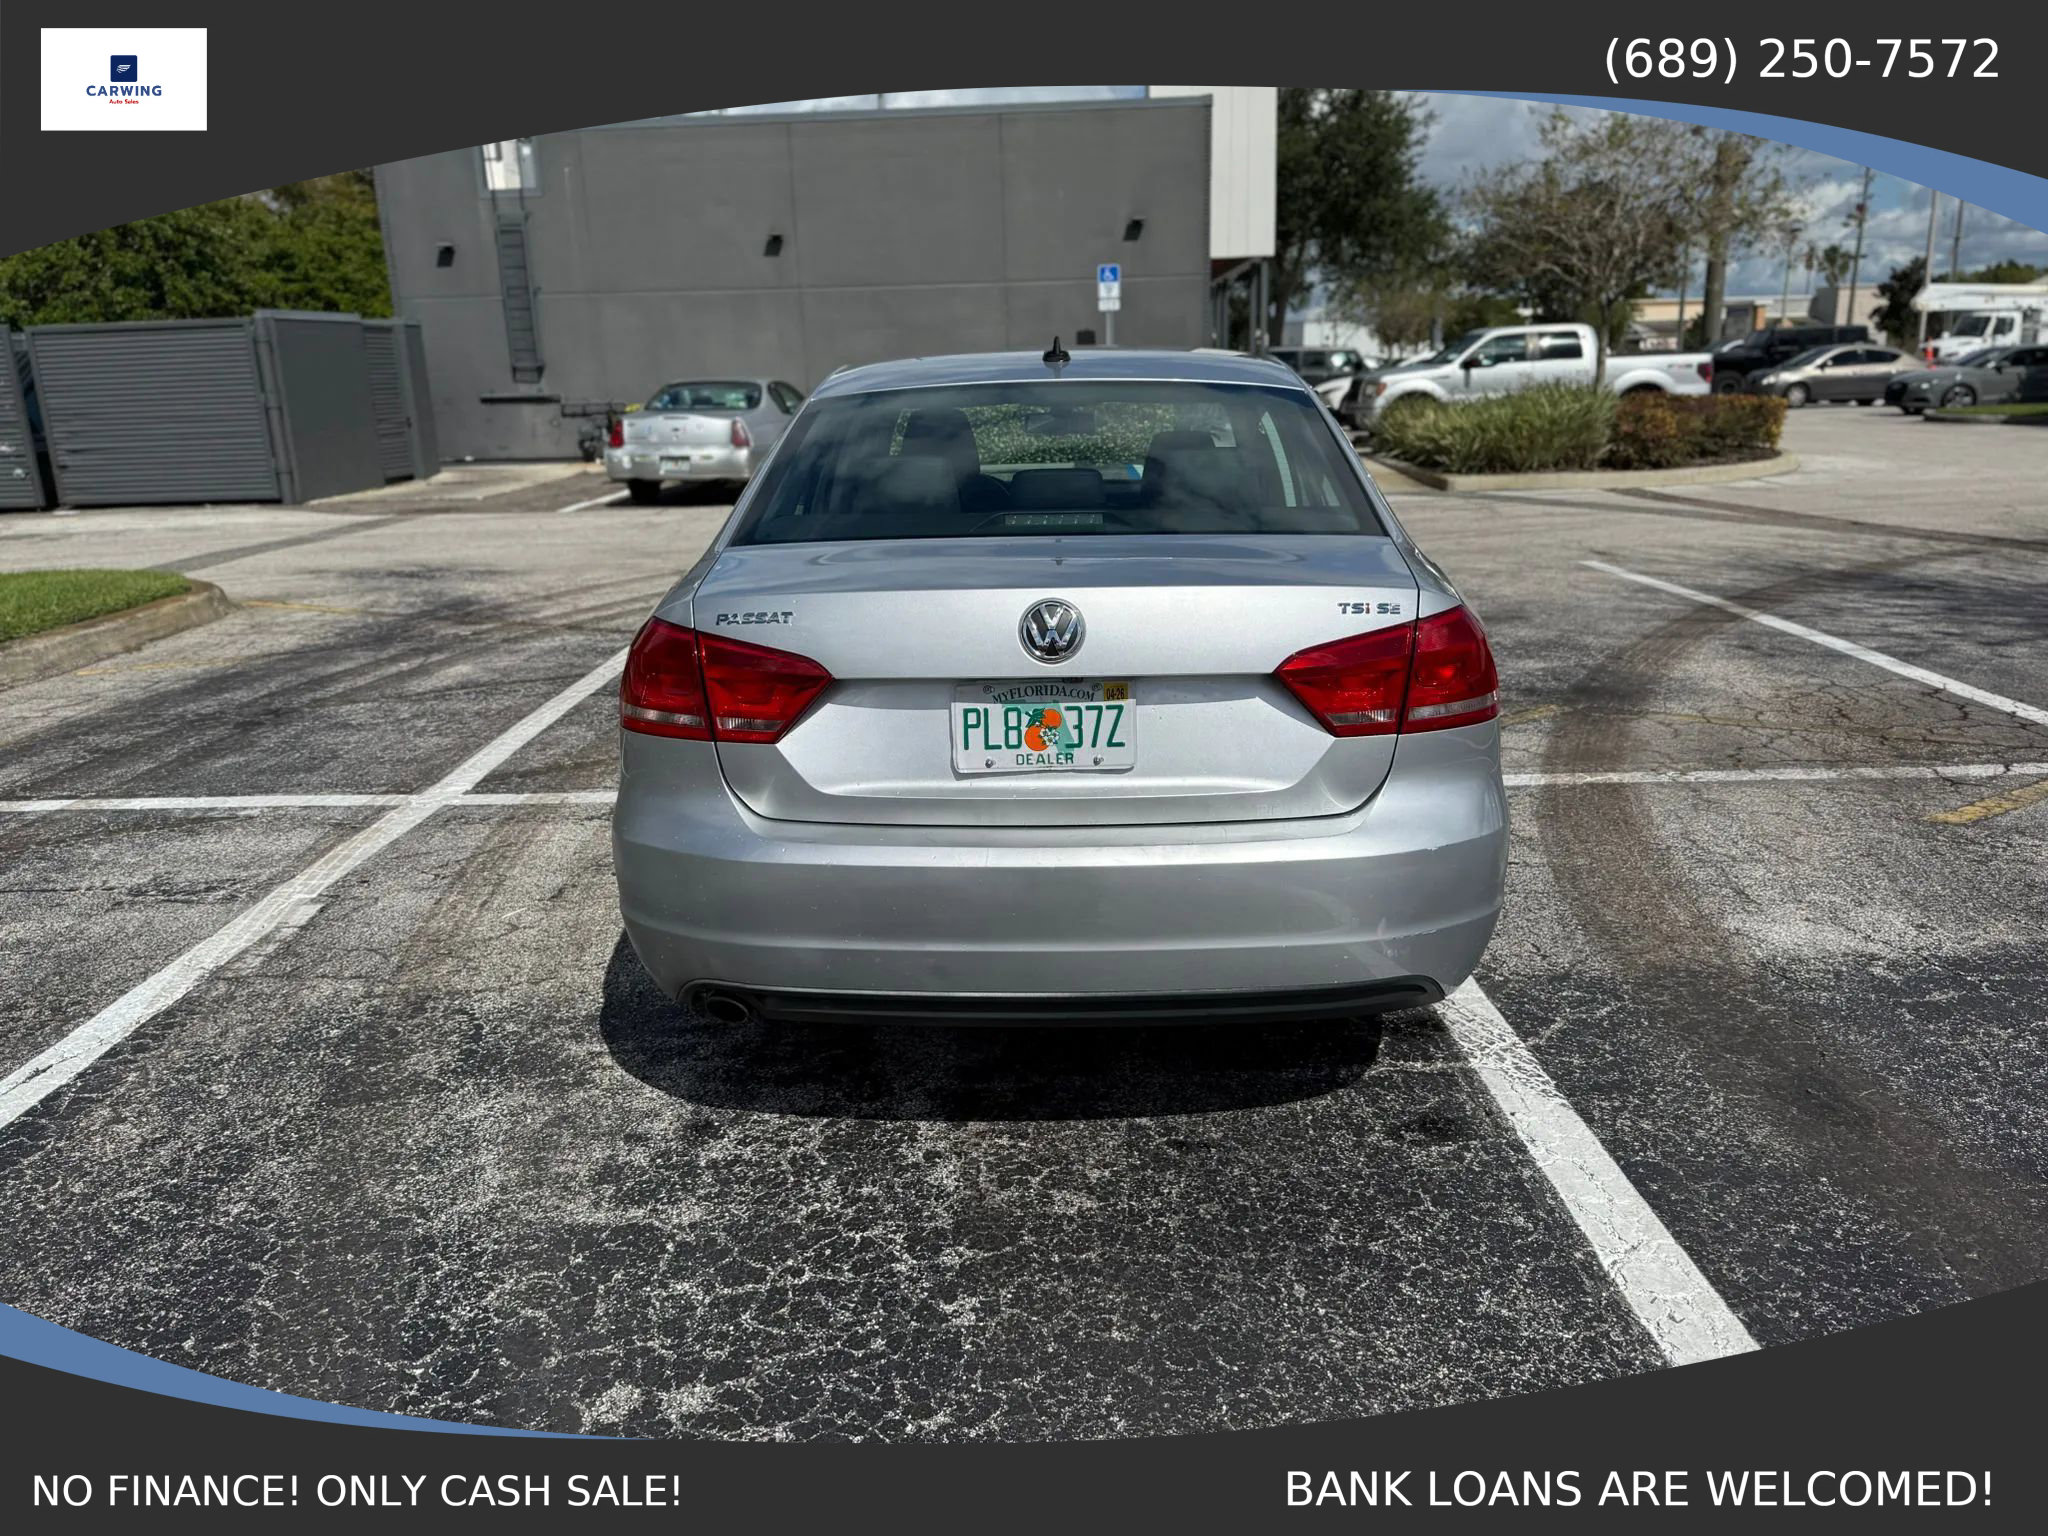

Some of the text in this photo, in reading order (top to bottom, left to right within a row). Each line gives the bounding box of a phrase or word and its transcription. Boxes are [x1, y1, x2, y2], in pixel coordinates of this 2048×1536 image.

[1376, 602, 1401, 615] SE
[715, 611, 794, 626] PASSAT
[992, 684, 1095, 704] MYFLORIDA.COM
[1016, 752, 1074, 766] DEALER
